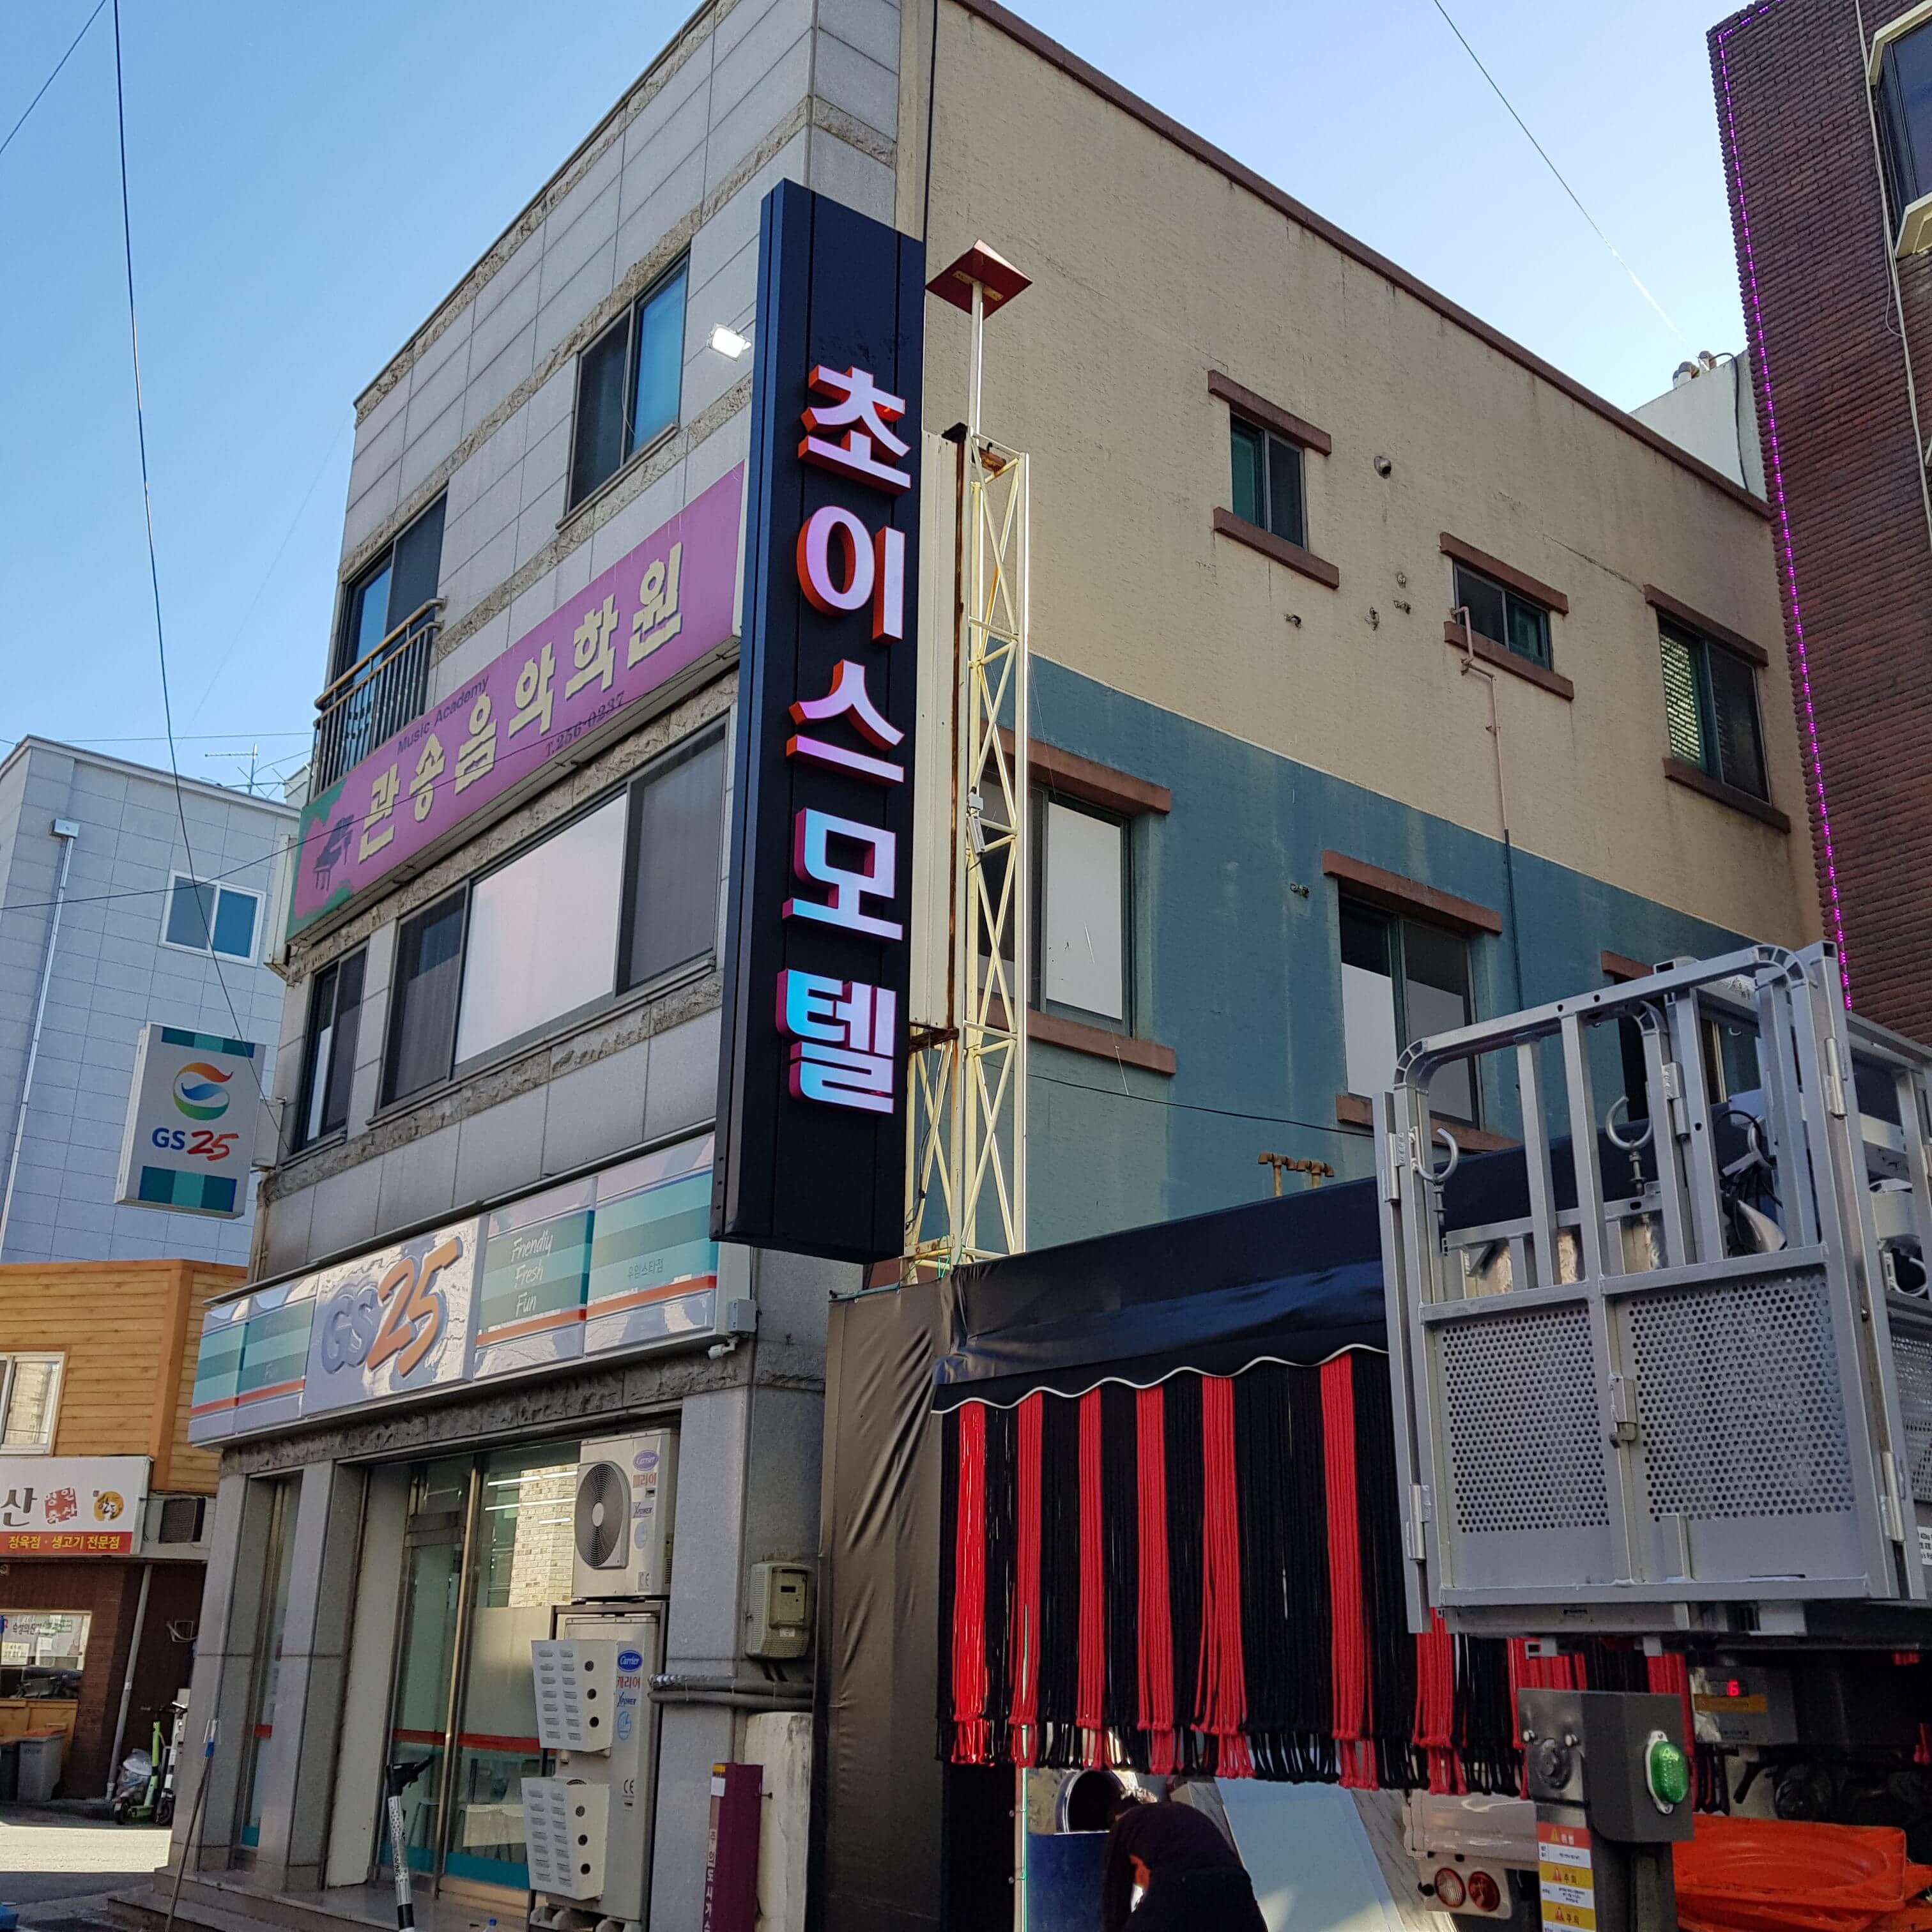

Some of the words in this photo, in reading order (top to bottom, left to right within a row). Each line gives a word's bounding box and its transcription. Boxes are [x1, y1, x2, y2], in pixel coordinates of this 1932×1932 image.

[397, 722, 431, 756] Music
[434, 675, 489, 727] Academy
[514, 1259, 543, 1289] Fresh
[516, 1292, 537, 1317] Fun
[8, 1535, 41, 1549] 정육점
[52, 1535, 83, 1549] 생고기
[87, 1535, 120, 1550] 전문점
[619, 1655, 640, 1666] Carrier
